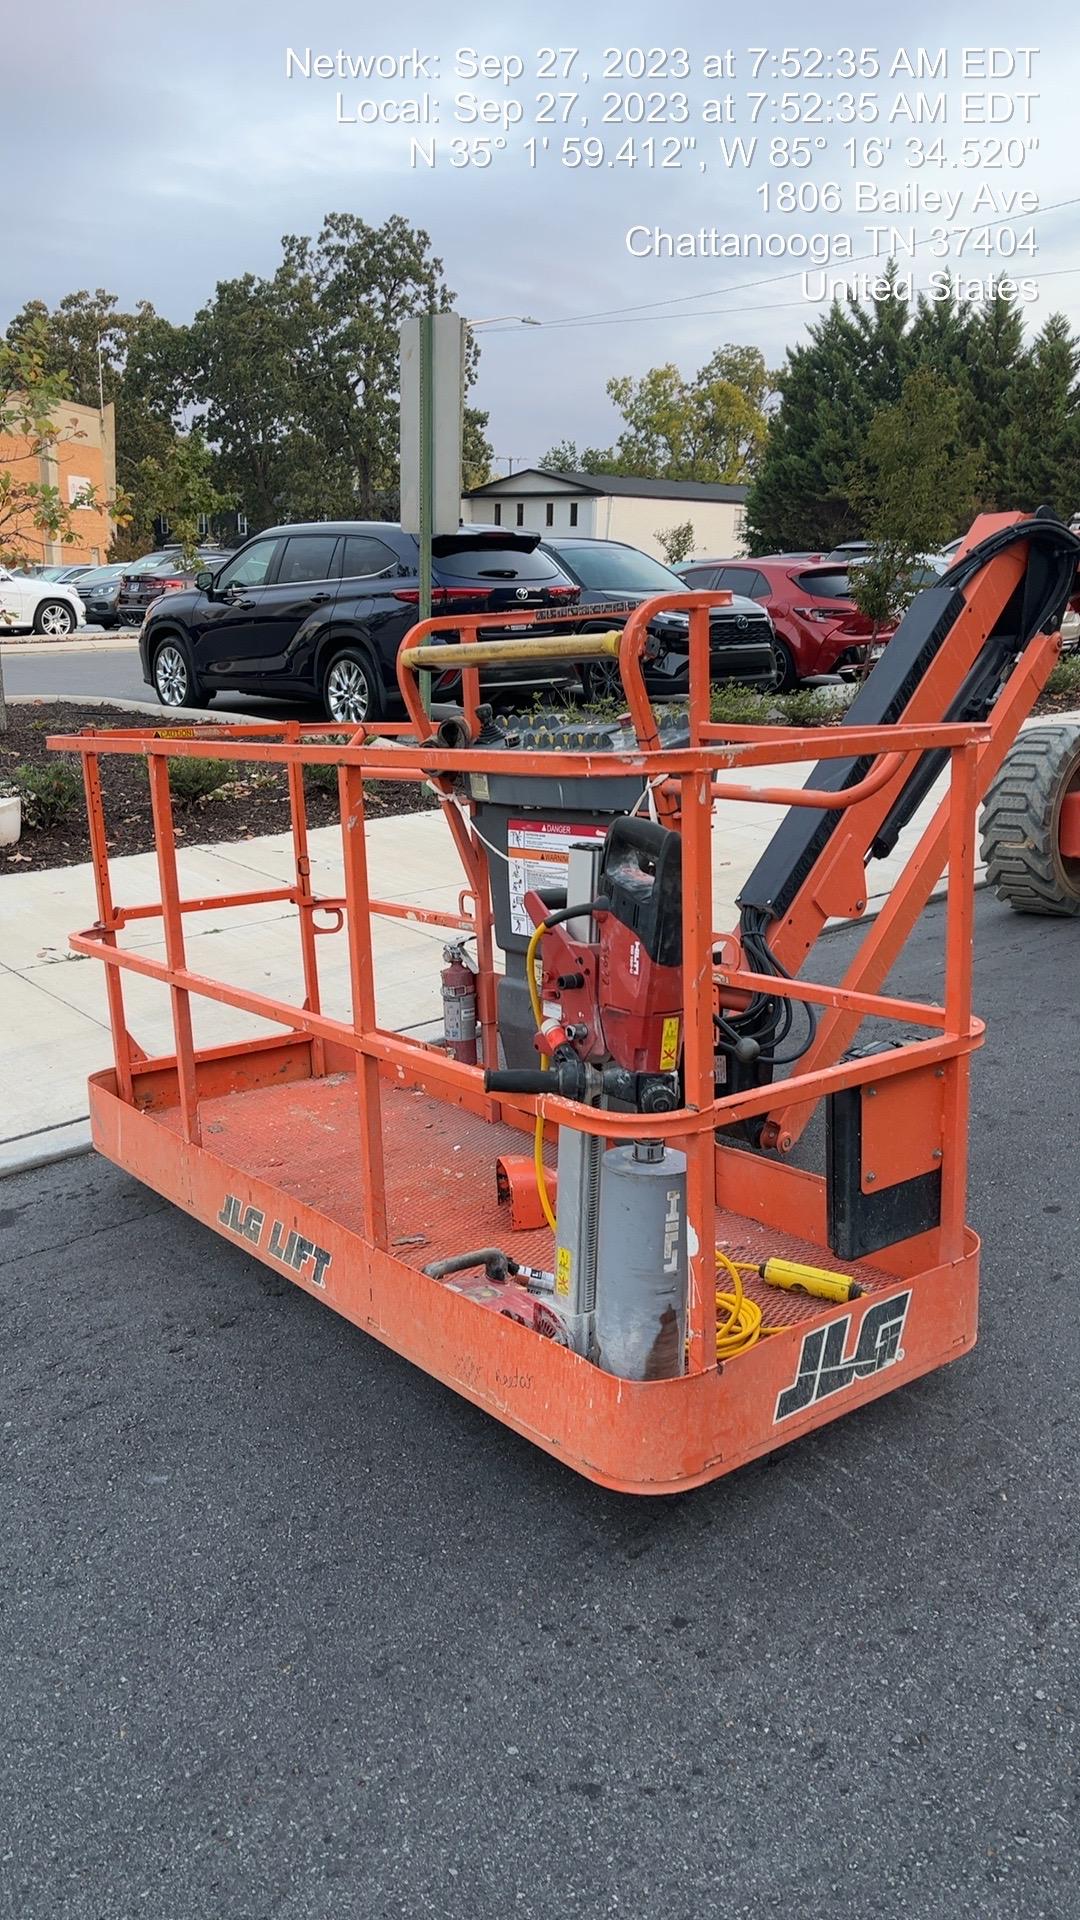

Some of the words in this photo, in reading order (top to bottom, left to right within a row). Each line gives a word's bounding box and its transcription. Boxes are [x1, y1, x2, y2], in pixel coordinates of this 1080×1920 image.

[547, 825, 571, 834] DANGER
[545, 854, 570, 863] WARNIN
[217, 1193, 265, 1247] JLG
[267, 1218, 332, 1288] LIFT
[772, 1287, 913, 1426] JLG
